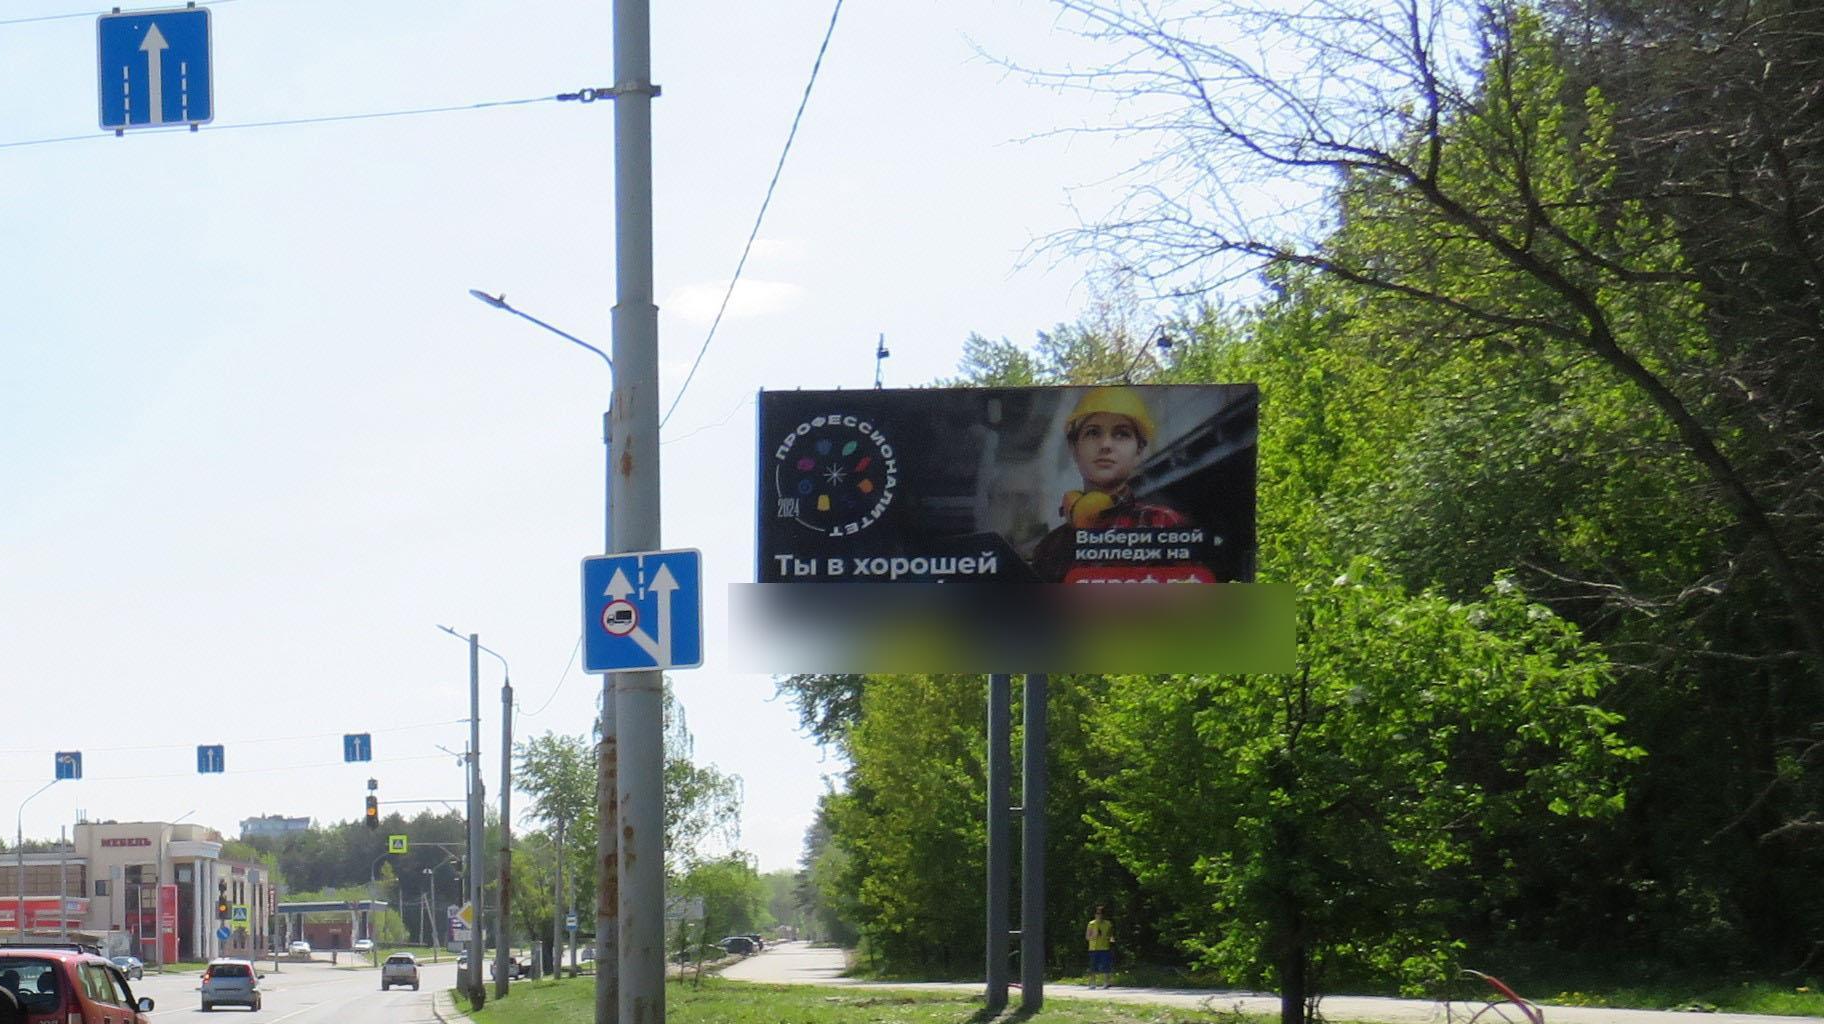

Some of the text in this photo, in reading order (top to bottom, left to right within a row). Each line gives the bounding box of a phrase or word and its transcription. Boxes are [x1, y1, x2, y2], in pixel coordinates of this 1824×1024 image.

[776, 414, 897, 537] ПРОФЕССИОНАЛИТЕТ
[777, 498, 800, 518] 2024
[1076, 528, 1204, 547] Выбери свой
[1076, 548, 1190, 561] колледж на
[774, 551, 998, 580] Ты в хорошей
[101, 837, 152, 848] МЕБЕЛЬ
